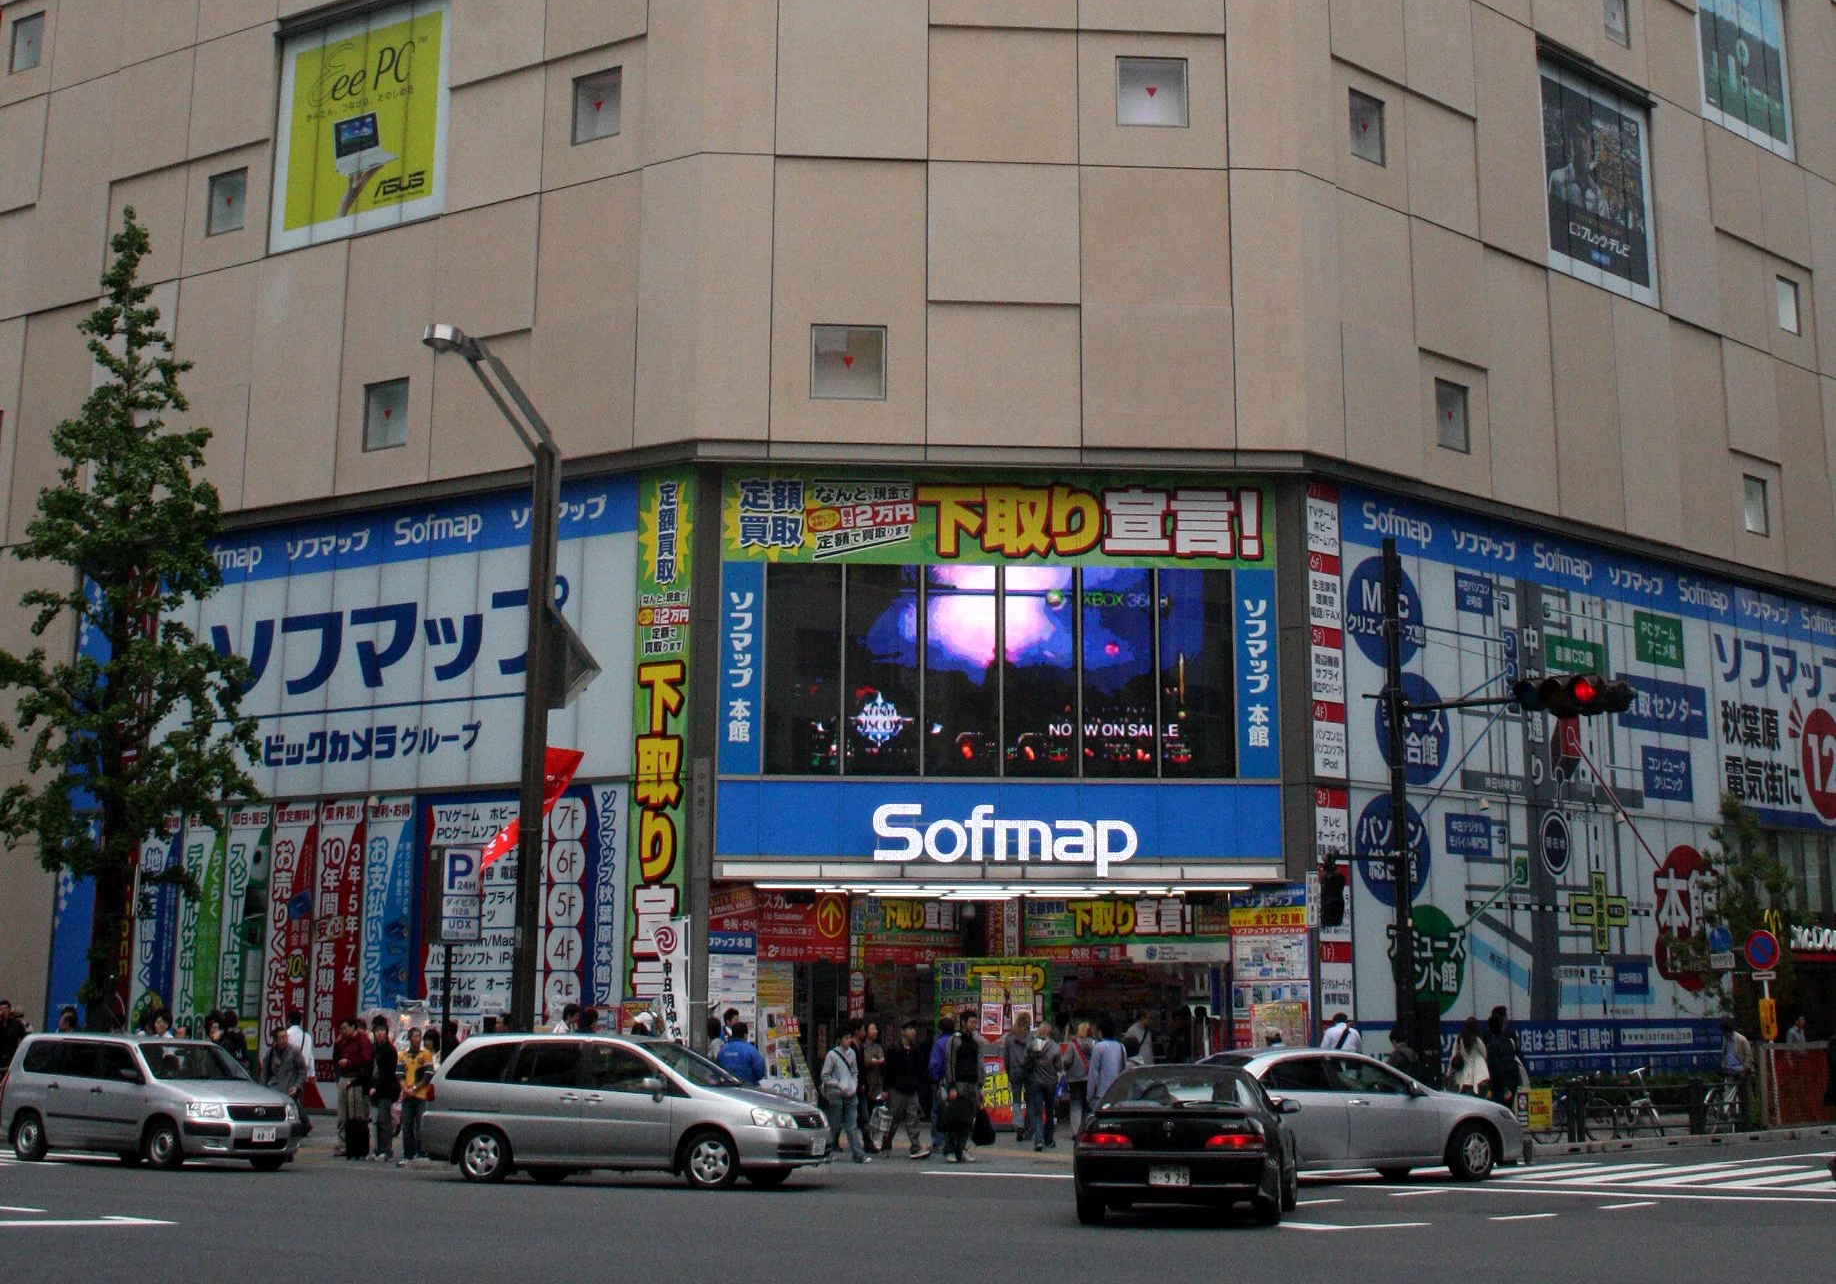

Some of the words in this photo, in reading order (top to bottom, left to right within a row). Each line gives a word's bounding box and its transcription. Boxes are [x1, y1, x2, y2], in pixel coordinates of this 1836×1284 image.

[373, 40, 416, 91] PC
[373, 170, 425, 198] ASUS
[739, 478, 804, 512] 定額
[393, 513, 484, 546] Sofmap
[855, 503, 915, 527] 2万円
[1308, 505, 1336, 521] TVゲーム
[1313, 521, 1332, 533] ホビー
[1362, 501, 1433, 549] Sofmap
[286, 527, 371, 560] ソフマップ
[655, 481, 678, 586] 定額買取
[739, 515, 804, 548] 買取
[1451, 527, 1516, 562] ソフマップ
[212, 544, 263, 573] fmap
[1310, 556, 1320, 572] 6F
[1533, 542, 1593, 585] Sofmap
[1608, 567, 1663, 596] ソフマップ
[1678, 577, 1729, 617] Sofmap
[729, 592, 754, 688] ソフマップ
[1243, 599, 1269, 693] ソフマップ
[1312, 628, 1322, 645] 5F
[728, 698, 751, 743] 本館
[1247, 704, 1269, 747] 本館
[1314, 705, 1325, 721] 4F
[1720, 699, 1781, 752] 秋葉原
[264, 720, 483, 768] ビックカメラグループ
[1049, 723, 1098, 737] NOW
[1102, 723, 1124, 737] ON
[1322, 757, 1338, 770] iPod
[1724, 754, 1802, 806] 電気街に
[1316, 789, 1328, 805] 3F
[437, 809, 479, 823] TVゲーム
[490, 806, 518, 820] ホビー
[557, 805, 579, 831] 7F
[1323, 816, 1341, 828] テレビ
[1360, 814, 1423, 848] パソン
[872, 803, 1138, 878] Sofmap
[449, 853, 474, 890] P
[556, 849, 577, 873] 6F
[210, 850, 222, 918] らくらく
[457, 881, 476, 891] 24H
[554, 892, 576, 917] 5F
[220, 843, 247, 1009] スピード配送
[265, 840, 295, 1048] お売りください
[553, 935, 575, 961] 4F
[1321, 944, 1332, 960] 1F
